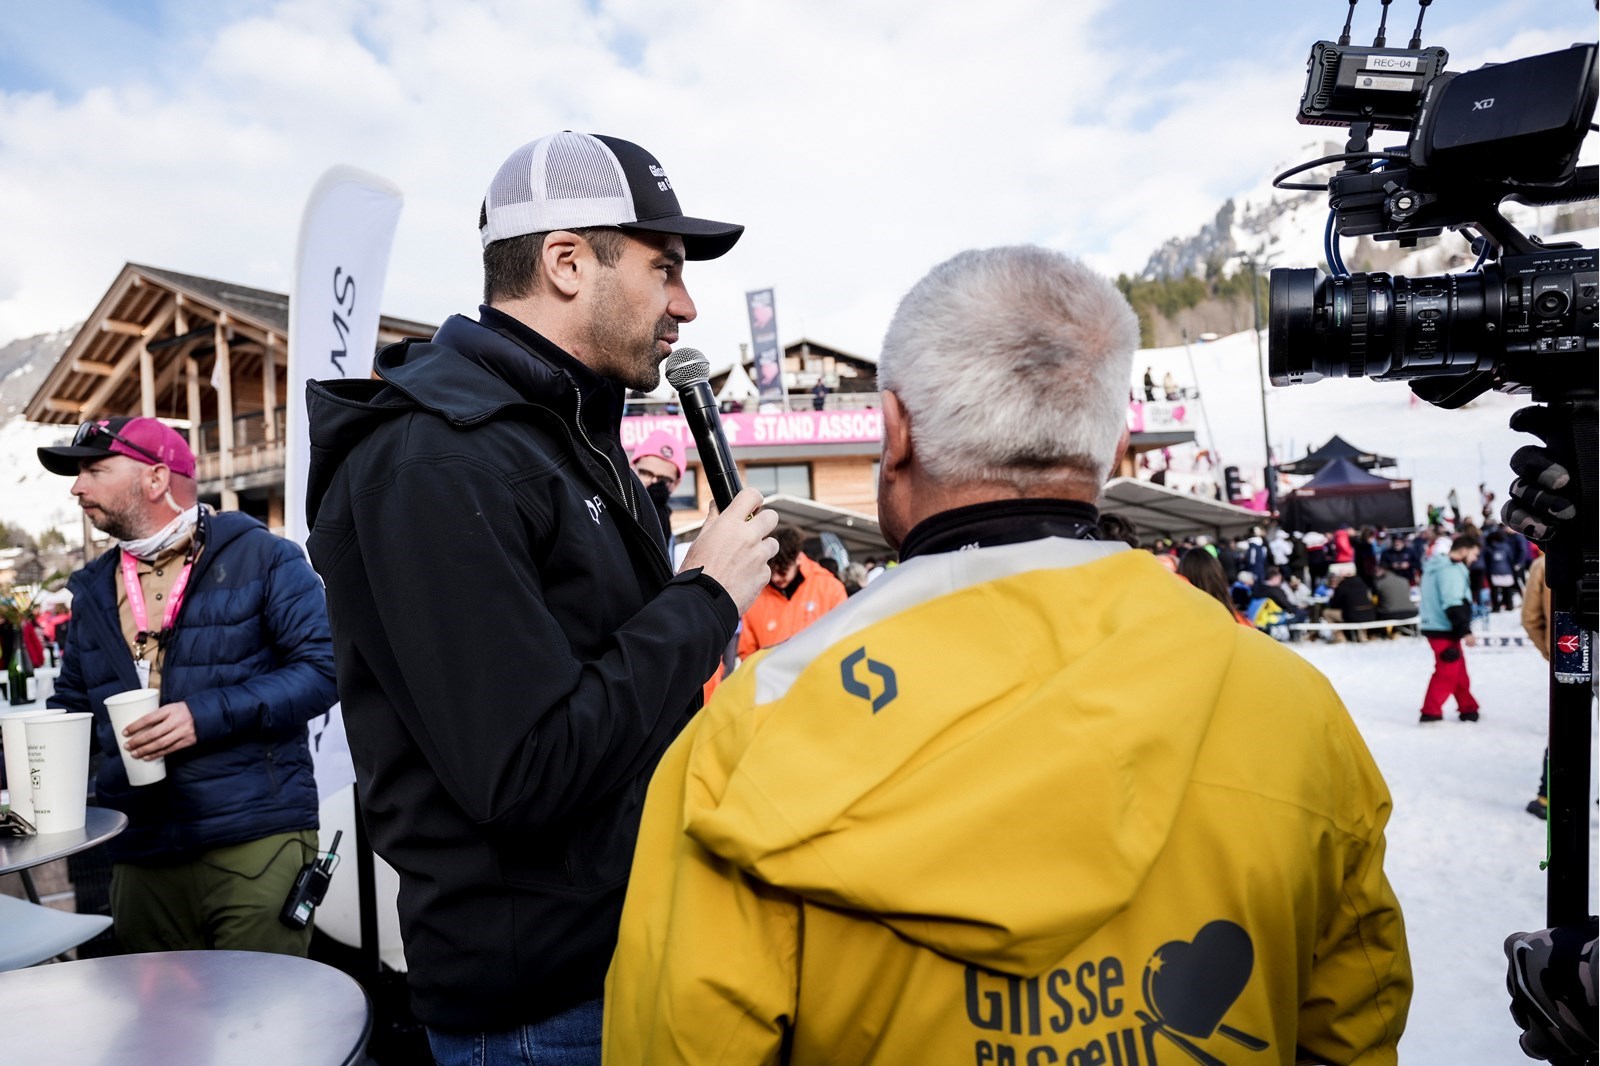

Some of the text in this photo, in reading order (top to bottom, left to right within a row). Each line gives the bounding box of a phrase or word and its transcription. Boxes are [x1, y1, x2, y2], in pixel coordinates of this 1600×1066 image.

[1373, 58, 1411, 68] REC-04
[753, 415, 815, 441] STAND
[965, 956, 1124, 1035] Glisse
